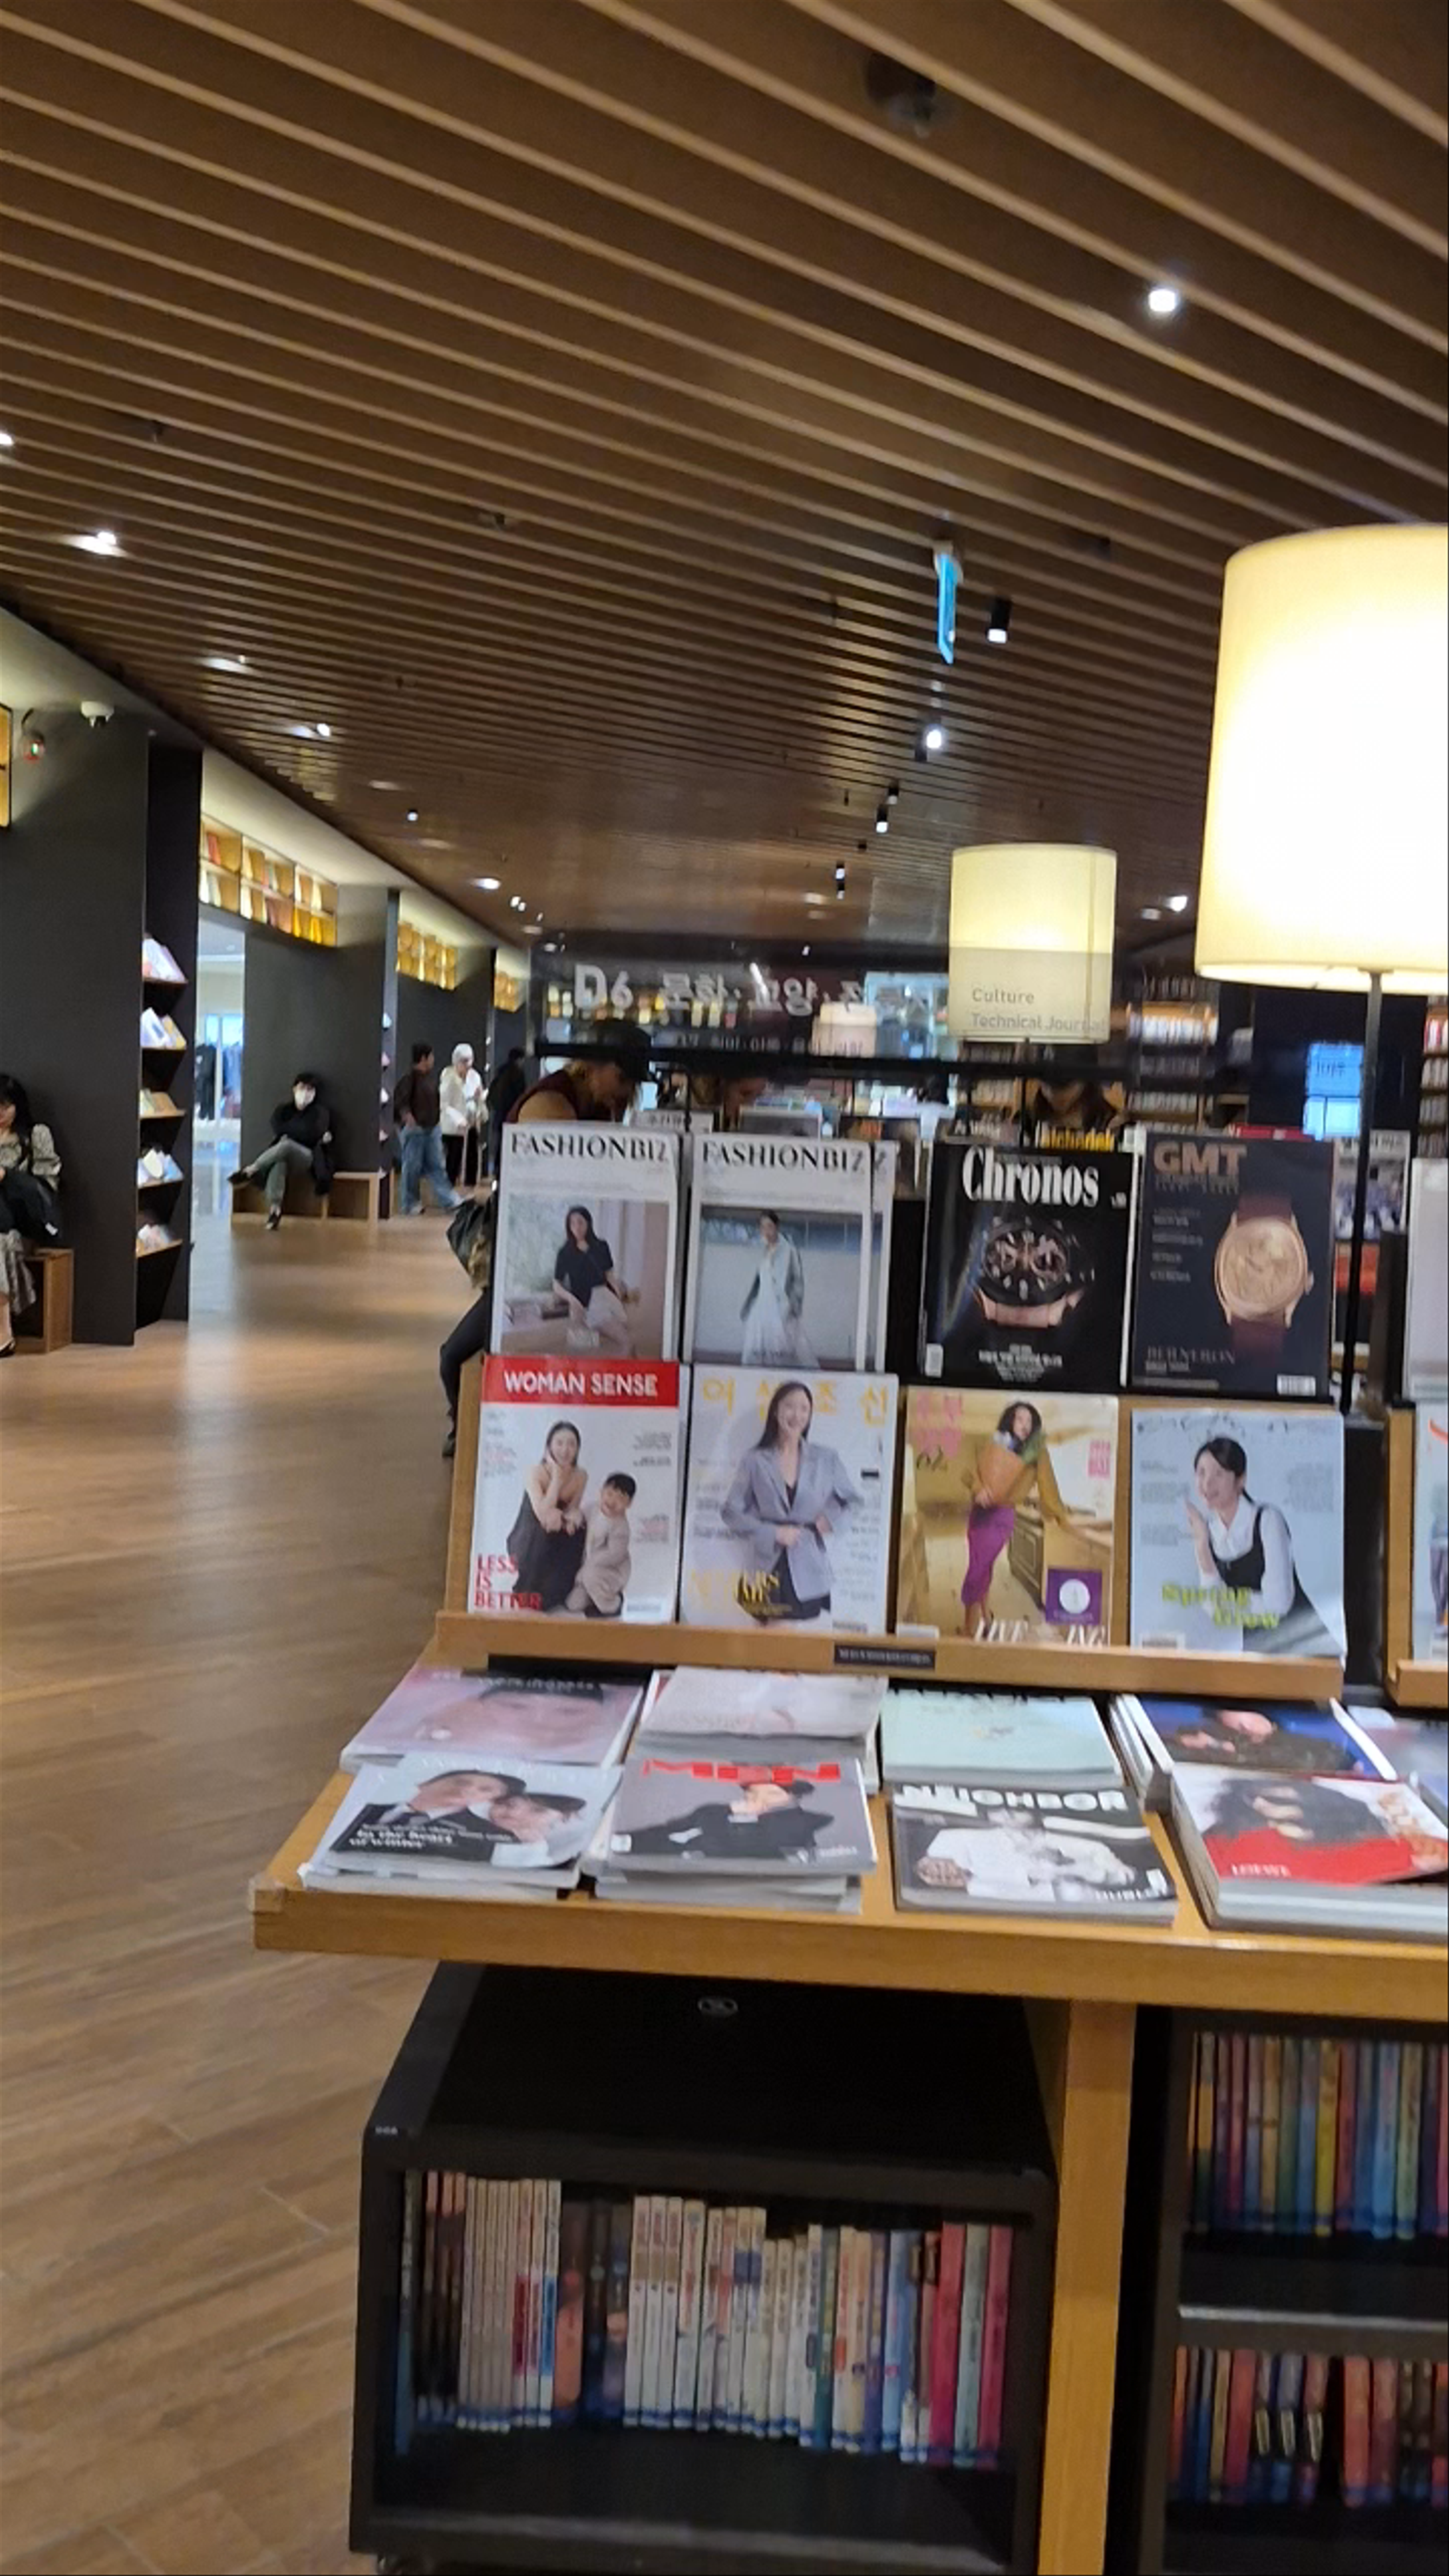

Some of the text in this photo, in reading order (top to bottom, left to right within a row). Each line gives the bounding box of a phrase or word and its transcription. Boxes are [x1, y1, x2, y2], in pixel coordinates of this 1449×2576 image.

[972, 988, 1035, 1004] Culture
[971, 1013, 1043, 1031] Technical
[1153, 1141, 1247, 1175] GMT
[962, 1145, 1100, 1207] Chronos
[504, 1370, 658, 1397] WOMAN SENSE
[477, 1553, 520, 1574] LESS
[476, 1575, 492, 1589] IS
[474, 1591, 544, 1611] BETTER
